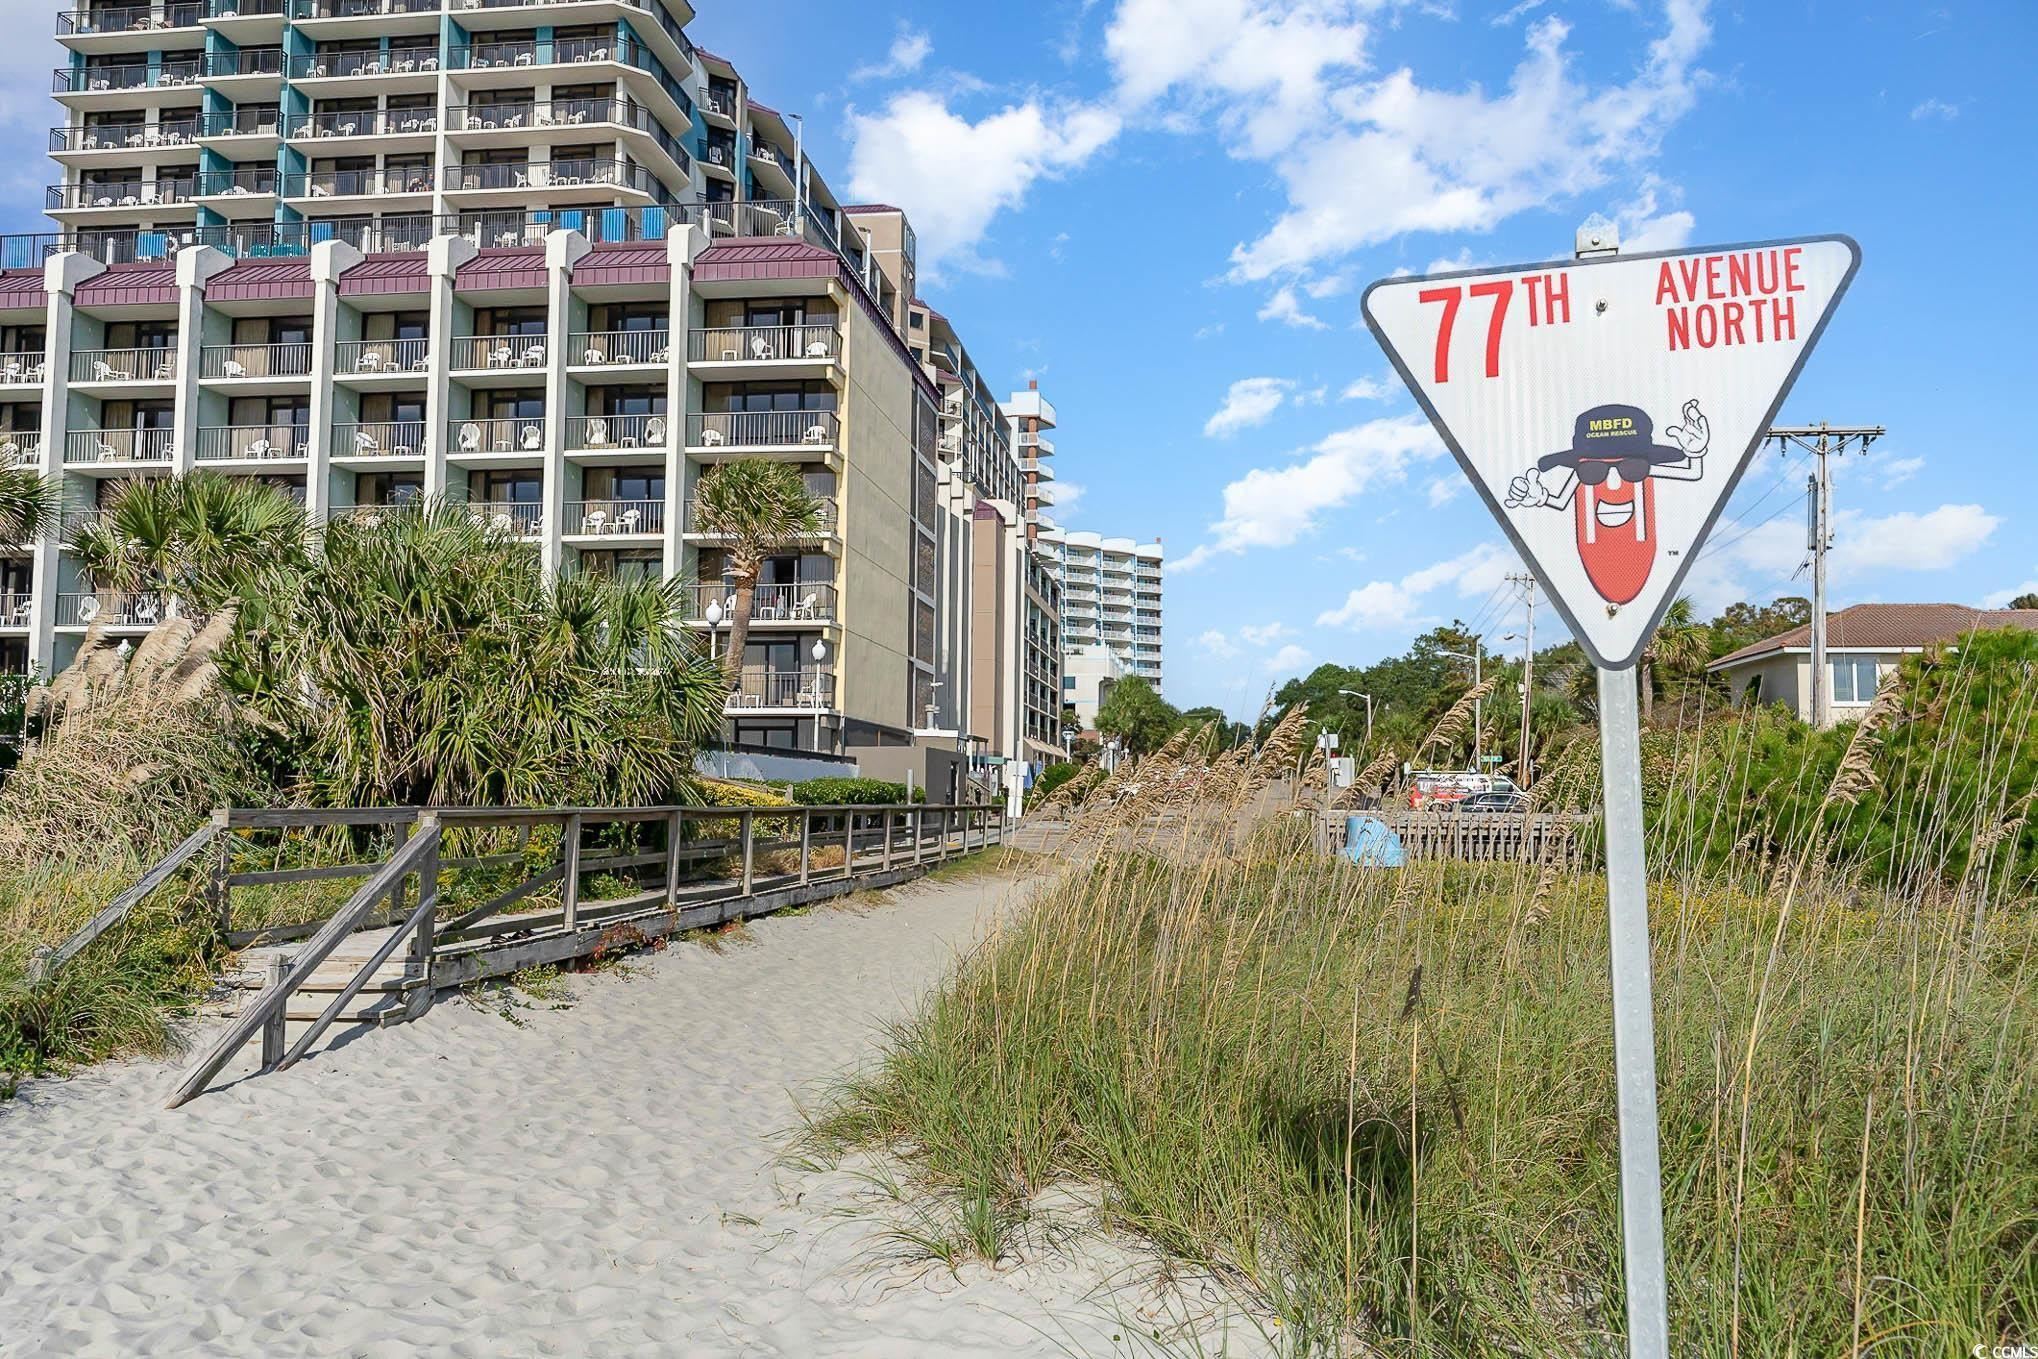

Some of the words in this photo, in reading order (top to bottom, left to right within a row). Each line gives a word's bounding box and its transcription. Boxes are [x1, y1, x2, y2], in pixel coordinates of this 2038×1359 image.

[1655, 247, 1805, 305] AVENUE
[1418, 272, 1571, 384] 77TH
[1666, 296, 1796, 352] NORTH
[1586, 431, 1610, 439] OCEAN
[1610, 429, 1638, 437] RESCUE
[1588, 417, 1633, 431] MBFD
